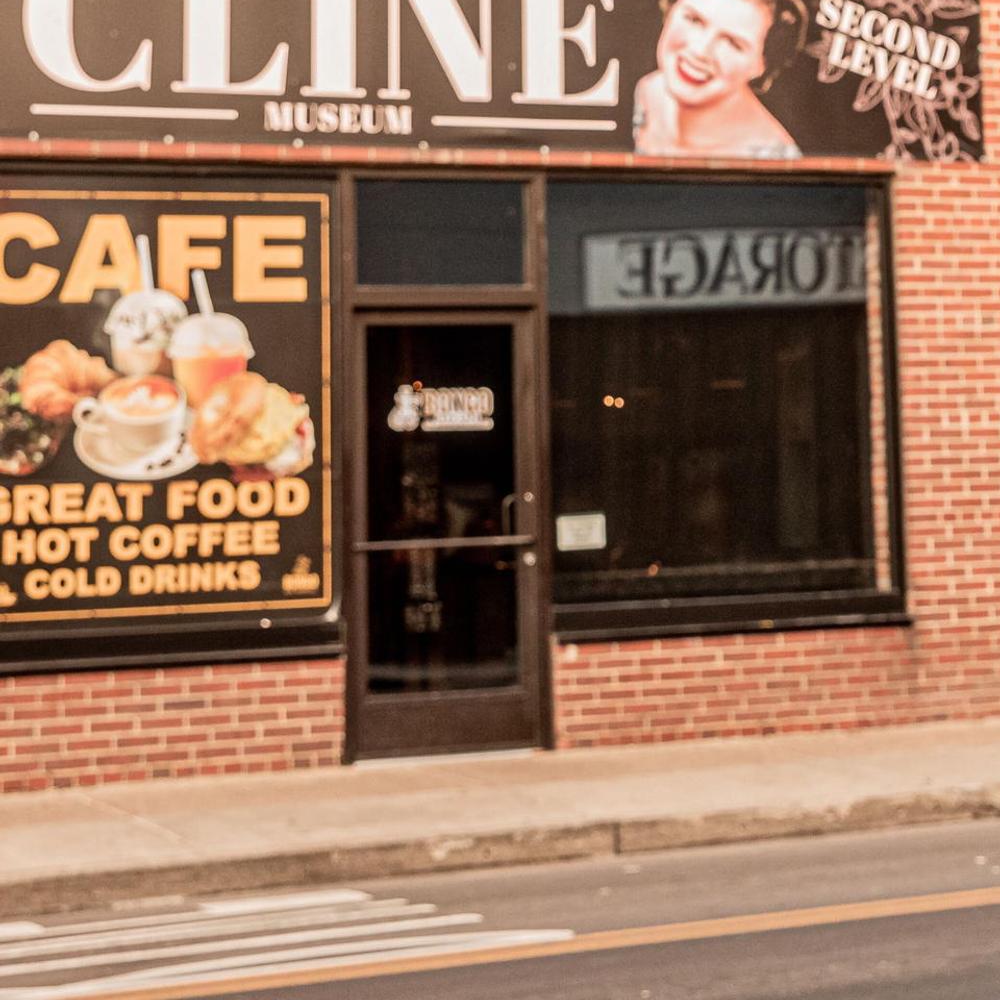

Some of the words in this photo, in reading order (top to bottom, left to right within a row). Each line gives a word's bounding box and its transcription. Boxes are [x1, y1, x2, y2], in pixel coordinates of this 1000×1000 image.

[828, 33, 941, 100] LEVEL
[264, 101, 413, 135] MUSEUM
[0, 211, 308, 304] CAFE
[166, 478, 311, 520] FOOD
[2, 527, 99, 565] HOT
[109, 521, 280, 561] COFFEE
[24, 566, 122, 600] COLD
[129, 560, 261, 595] DRINKS
